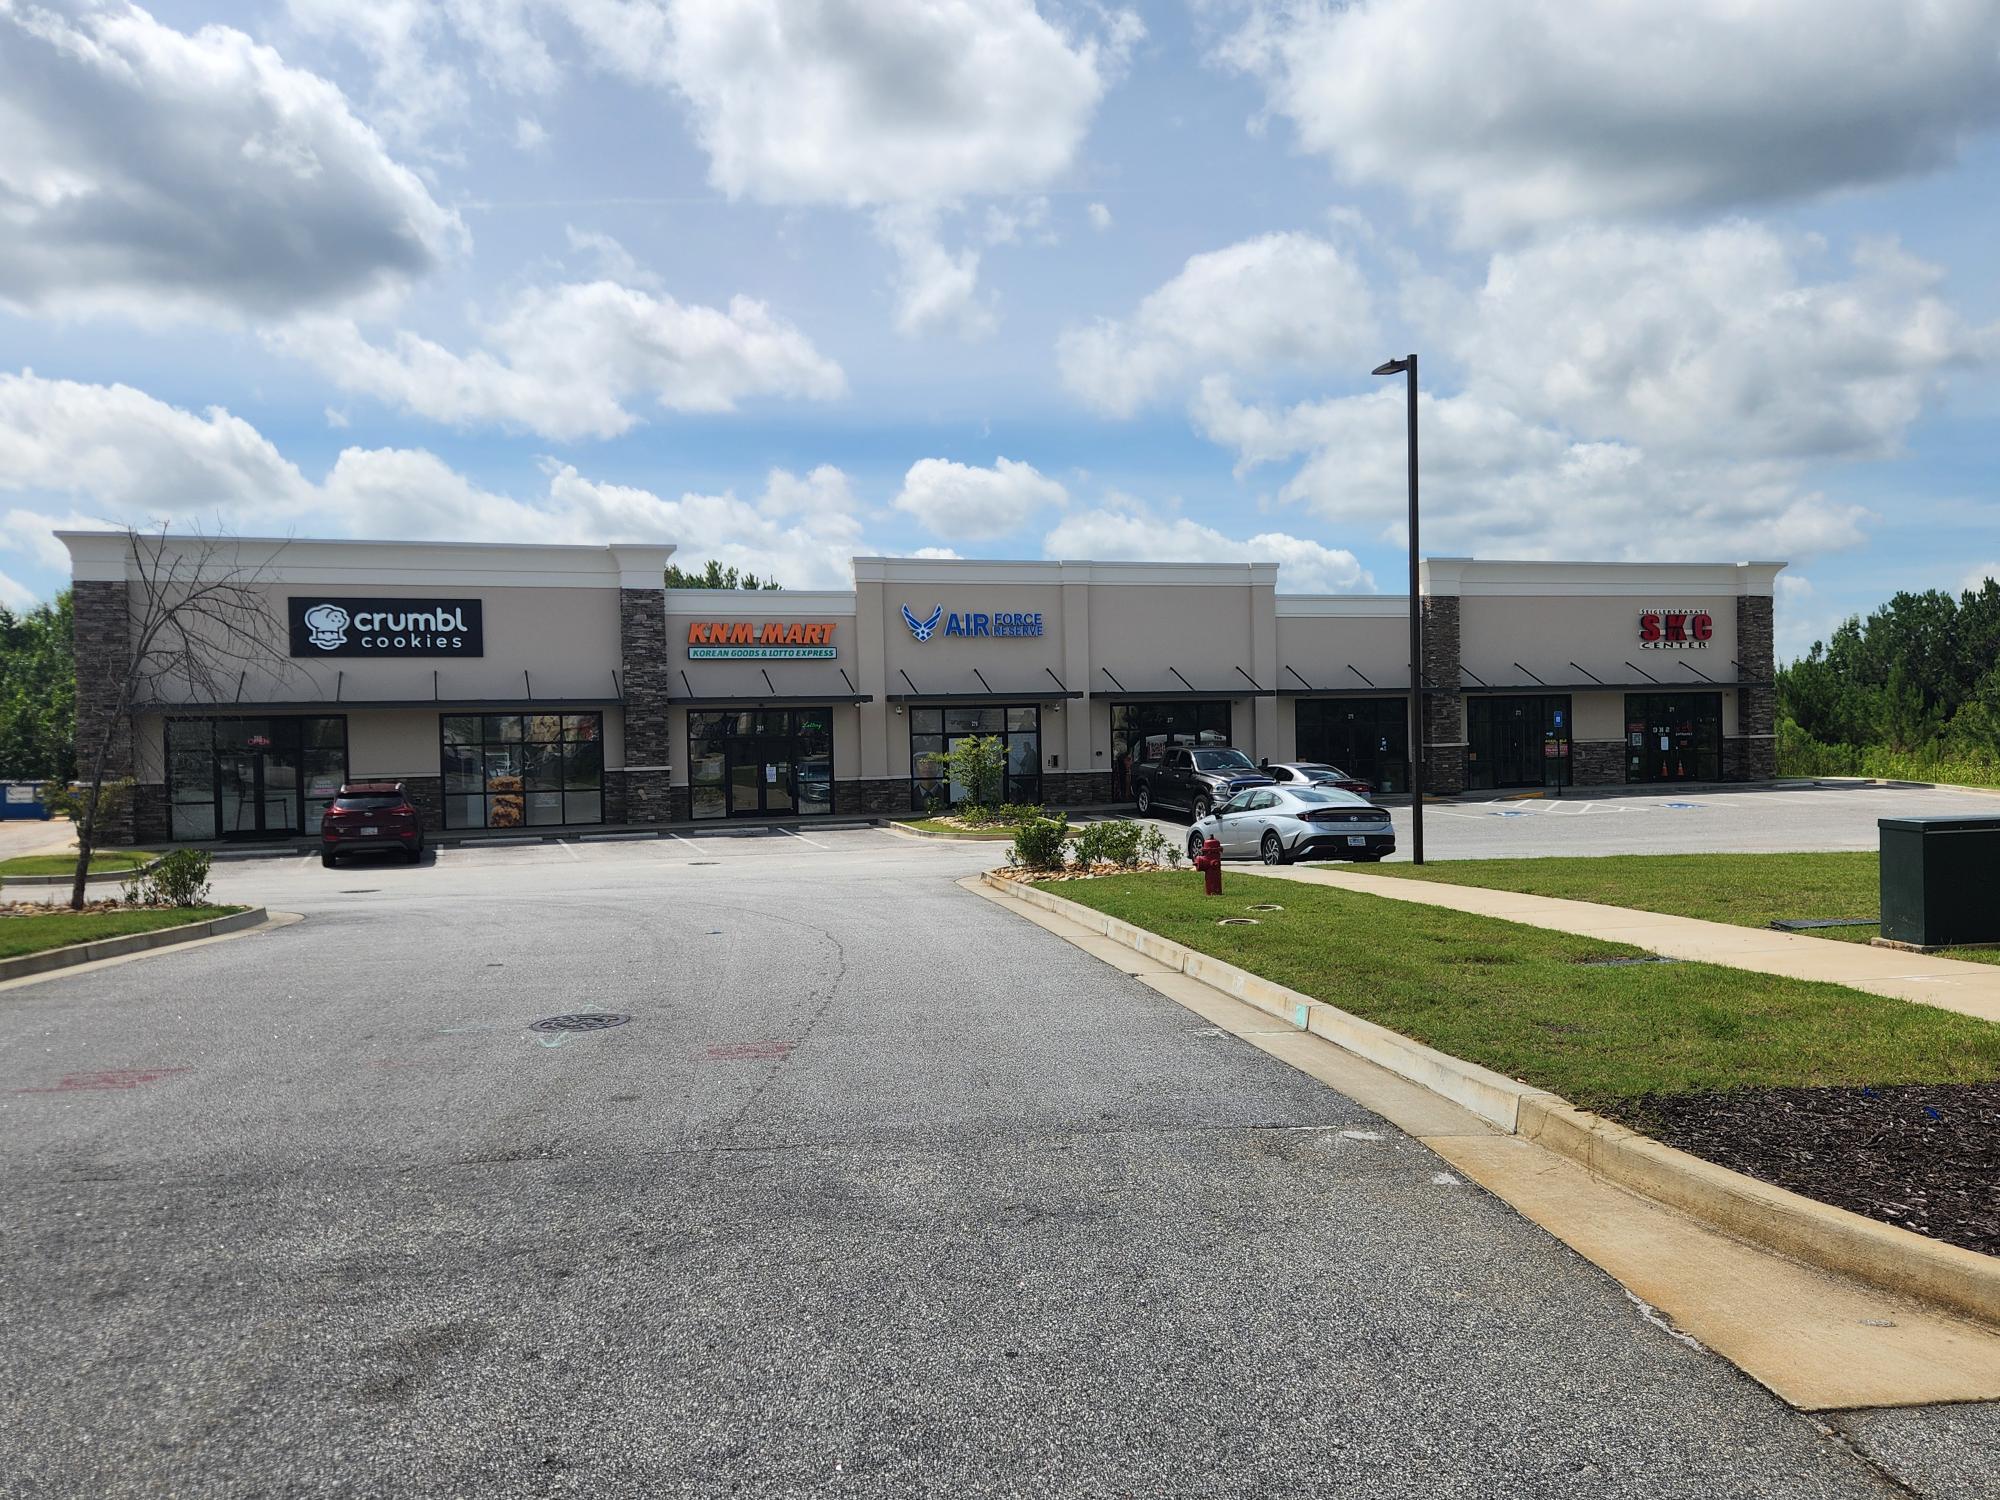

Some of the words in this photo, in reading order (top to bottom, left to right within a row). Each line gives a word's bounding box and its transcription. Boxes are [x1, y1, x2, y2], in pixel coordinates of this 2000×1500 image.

[354, 607, 468, 632] crumbl
[944, 612, 989, 637] AIR
[993, 613, 1043, 625] FORCE
[1640, 614, 1713, 641] SKC
[760, 622, 838, 644] MART
[993, 625, 1043, 636] RESERVE
[361, 633, 462, 648] cookies
[1640, 641, 1709, 649] CENTER
[692, 649, 729, 658] KOREAN
[730, 649, 760, 658] GOODS
[761, 649, 767, 658] &
[769, 649, 795, 658] LOTTO
[795, 649, 834, 657] EXPRESS
